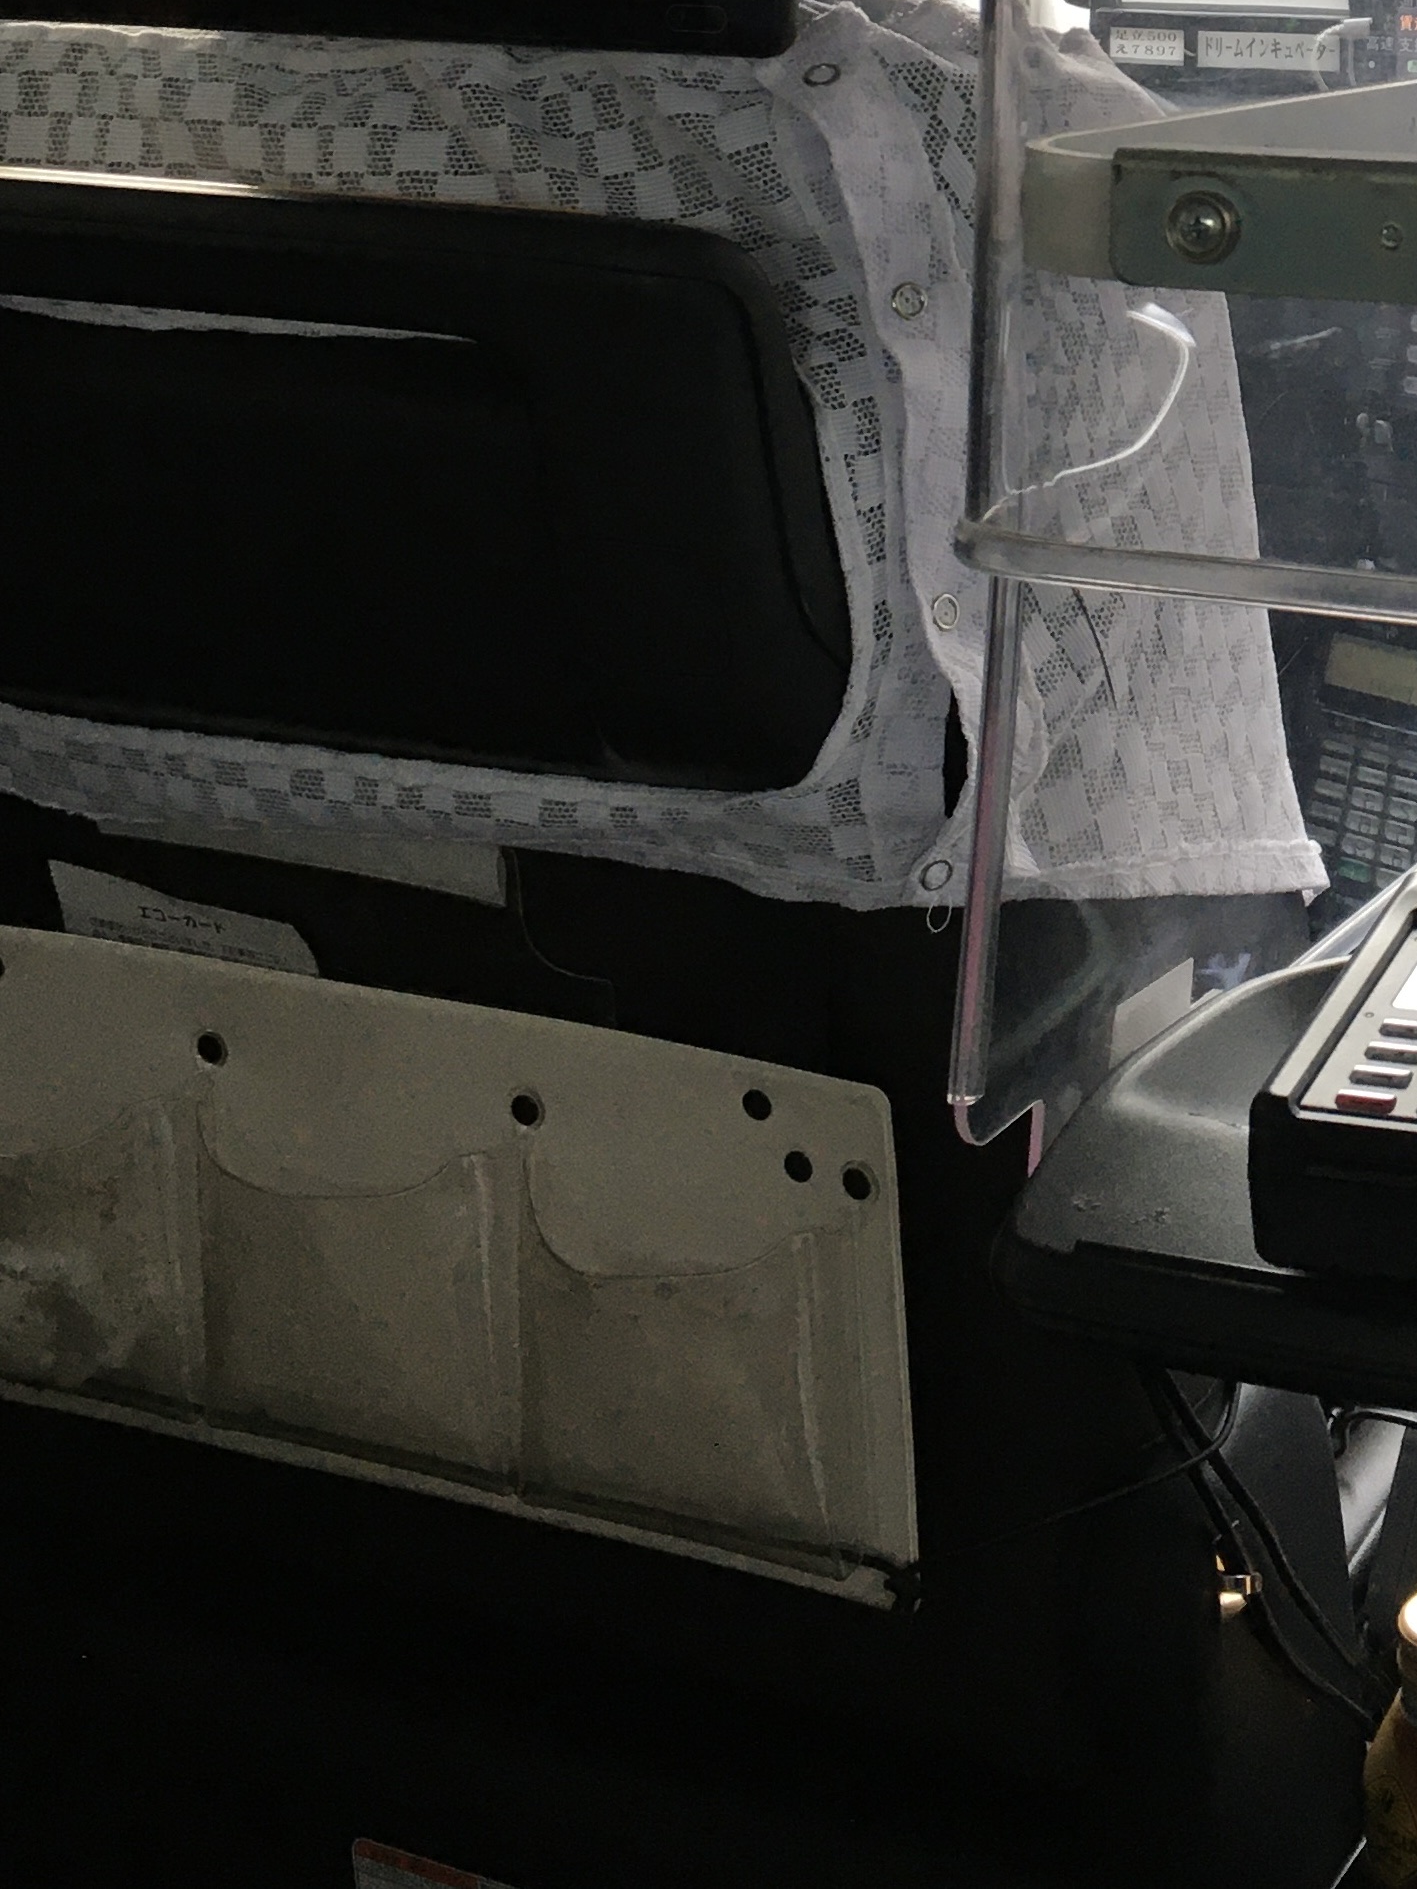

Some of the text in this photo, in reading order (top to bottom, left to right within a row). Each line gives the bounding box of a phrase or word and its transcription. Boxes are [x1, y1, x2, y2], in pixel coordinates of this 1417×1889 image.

[1115, 29, 1177, 42] 足立500
[1115, 43, 1177, 56] え7897
[1205, 36, 1336, 60] ドリームインキュベーター
